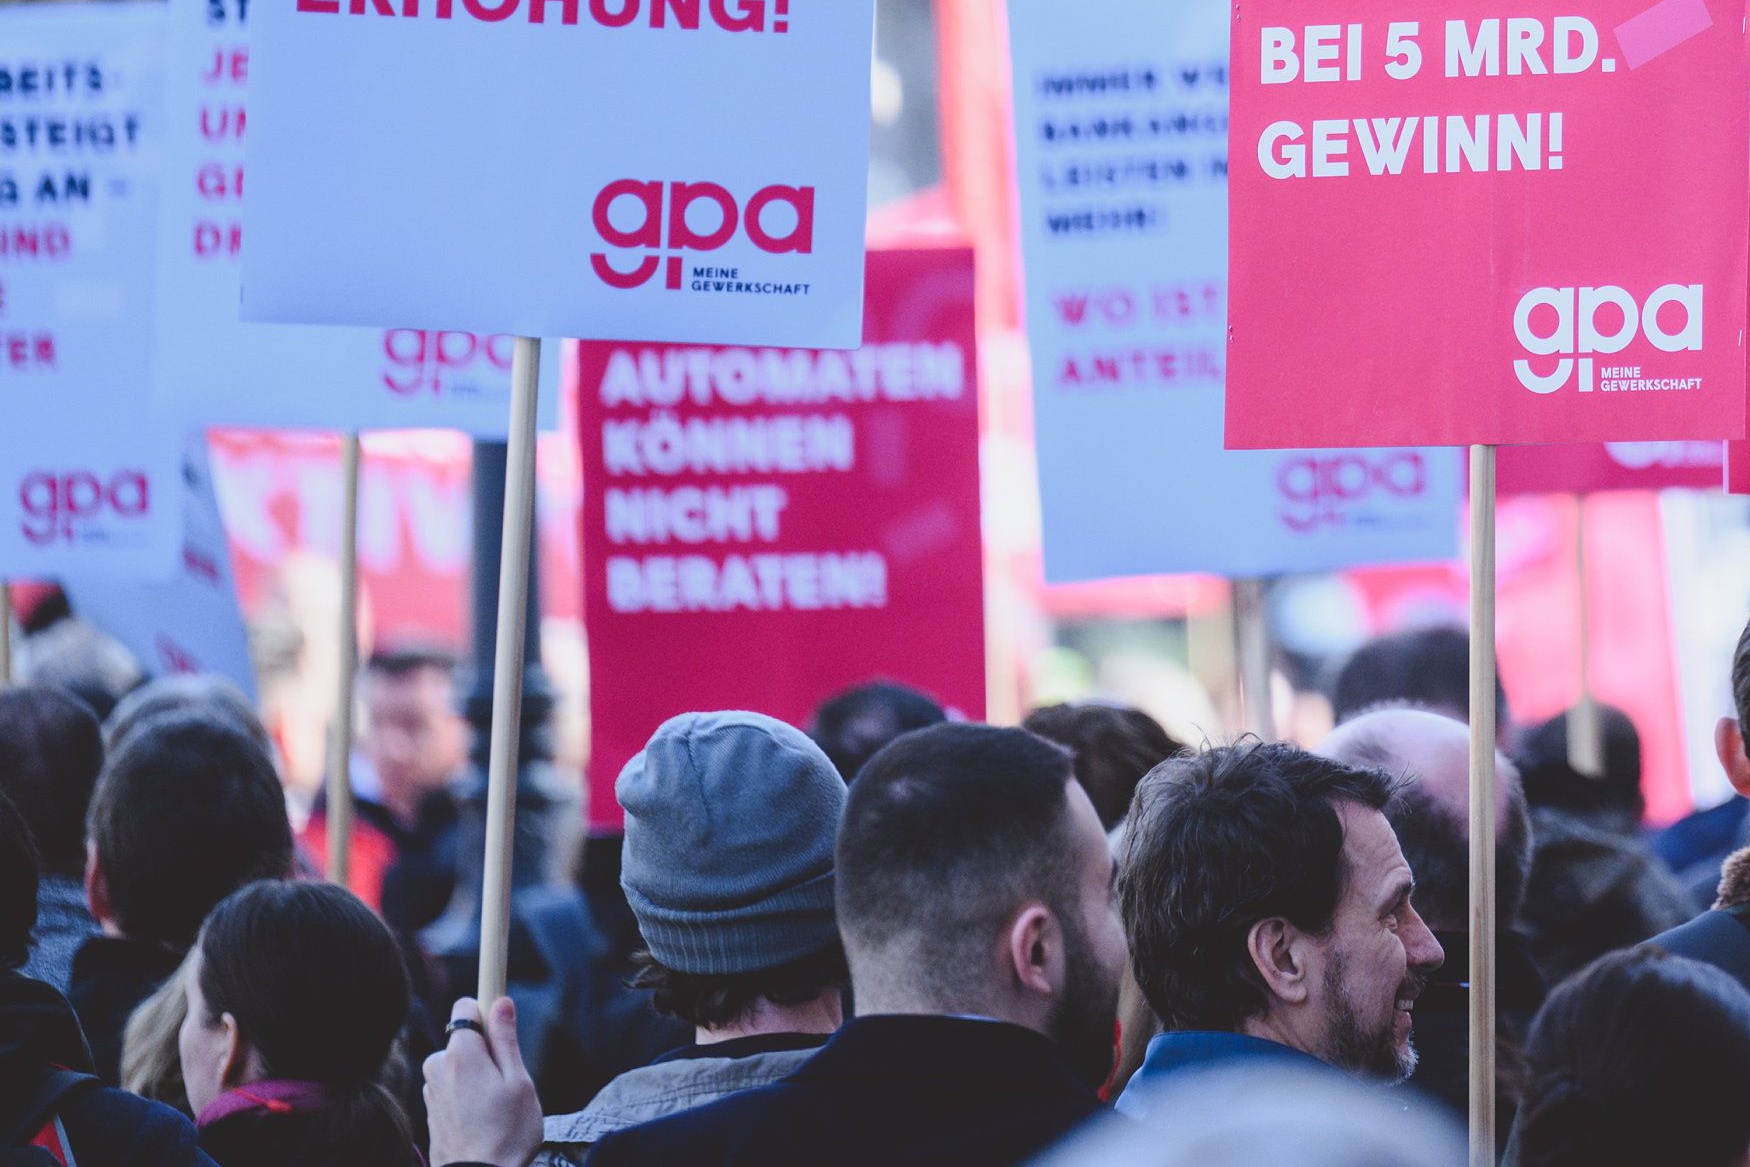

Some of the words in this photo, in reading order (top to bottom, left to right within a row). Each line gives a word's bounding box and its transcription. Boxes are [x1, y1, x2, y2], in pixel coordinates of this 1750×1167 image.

[1260, 23, 1362, 84] BEI
[1384, 21, 1422, 80] 5
[1444, 15, 1616, 78] MRD.
[1257, 112, 1564, 180] GEWINN!
[590, 178, 815, 290] gpa
[691, 280, 811, 295] GEWERKSCHAFT
[693, 267, 738, 279] MEINE
[1513, 284, 1704, 394] gpa
[600, 342, 965, 409] AUTOMATEN
[1600, 378, 1702, 392] GEWERKSCHAFT
[1601, 366, 1641, 379] MEINE
[602, 409, 856, 477] KÖNNEN
[604, 485, 788, 545] NICHT
[606, 549, 888, 614] BERATEN!
